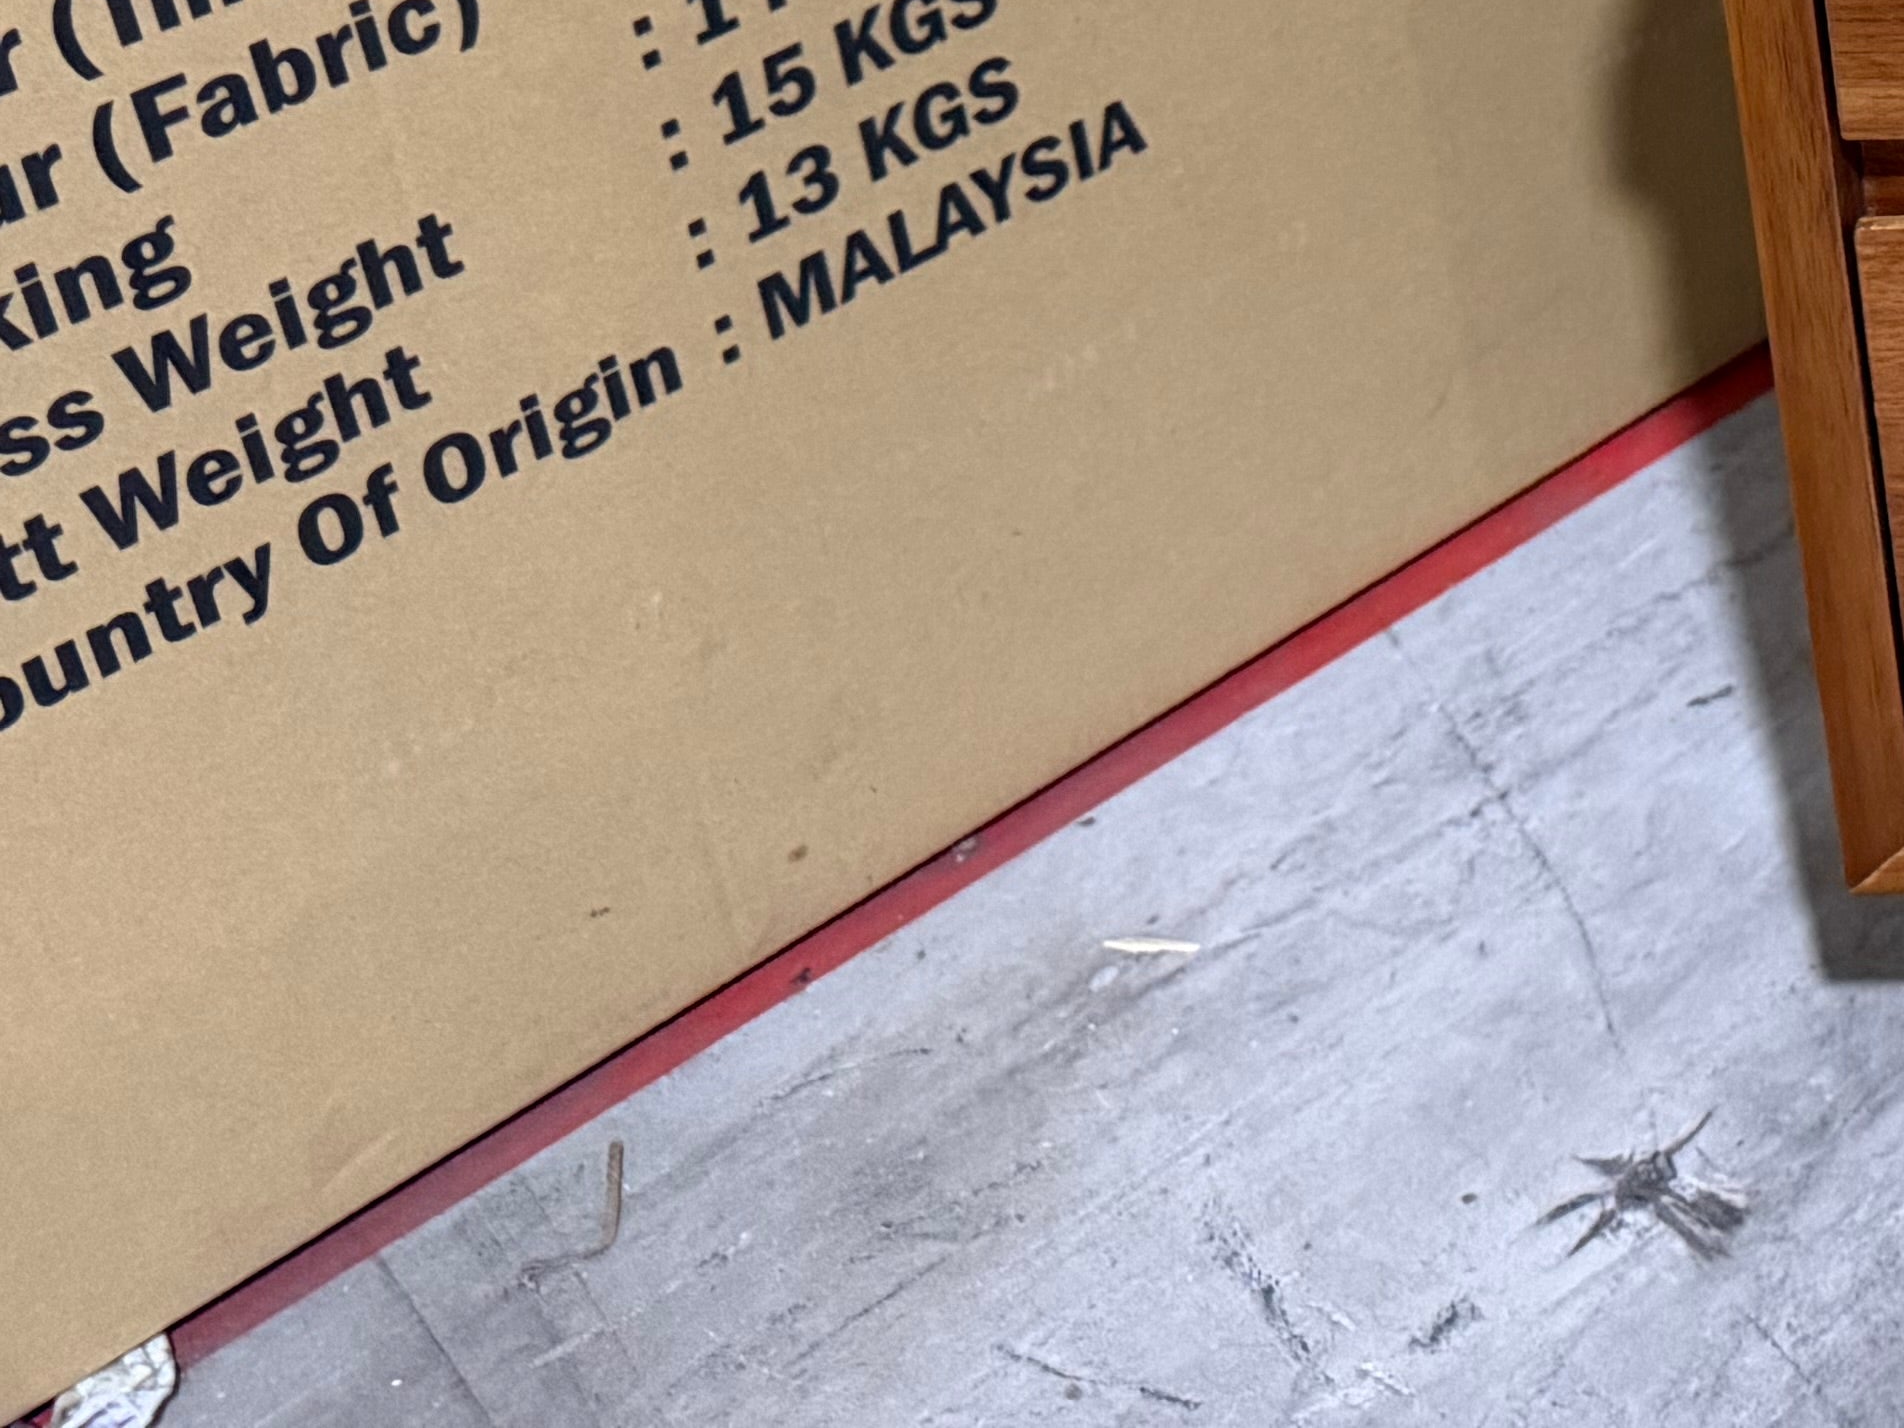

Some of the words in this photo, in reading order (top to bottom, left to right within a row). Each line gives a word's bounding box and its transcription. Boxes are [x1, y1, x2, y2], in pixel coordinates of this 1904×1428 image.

[77, 345, 433, 551] Weight
[737, 143, 841, 245] 13
[857, 55, 1020, 183] KGS
[109, 212, 466, 414] Weight
[710, 41, 817, 147] 15
[296, 461, 401, 567] Of
[421, 345, 684, 505] Origin
[756, 99, 1149, 341] MALAYSIA
